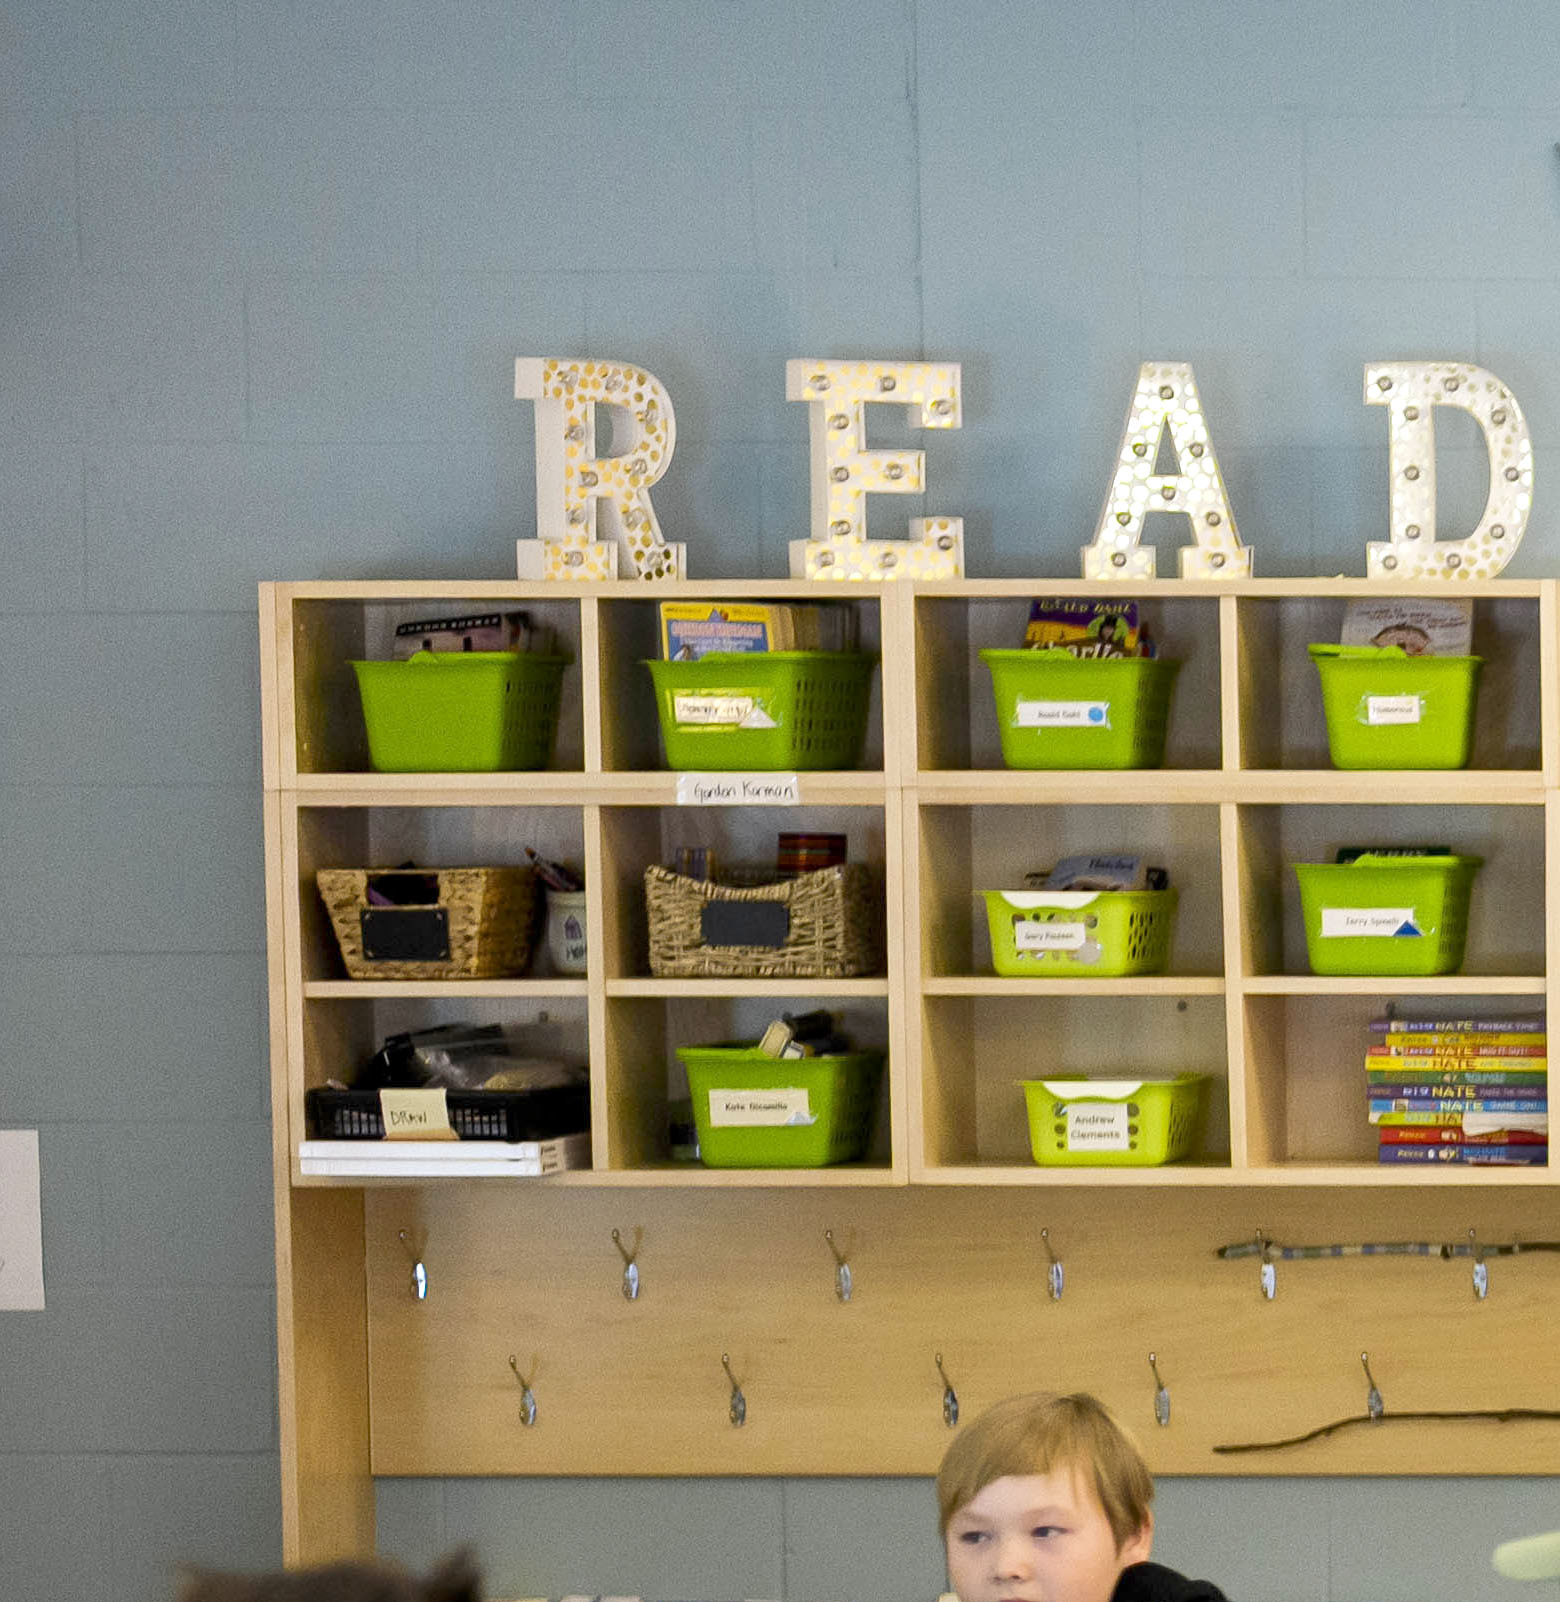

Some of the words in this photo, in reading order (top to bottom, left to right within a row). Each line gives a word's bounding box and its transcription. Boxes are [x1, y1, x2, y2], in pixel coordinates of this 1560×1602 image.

[516, 358, 1534, 580] READ
[1432, 1056, 1477, 1070] NATE
[1431, 1085, 1477, 1098] NATE
[1440, 1101, 1484, 1112] NATE
[1075, 1115, 1116, 1125] Andrew
[1070, 1130, 1121, 1141] Clements
